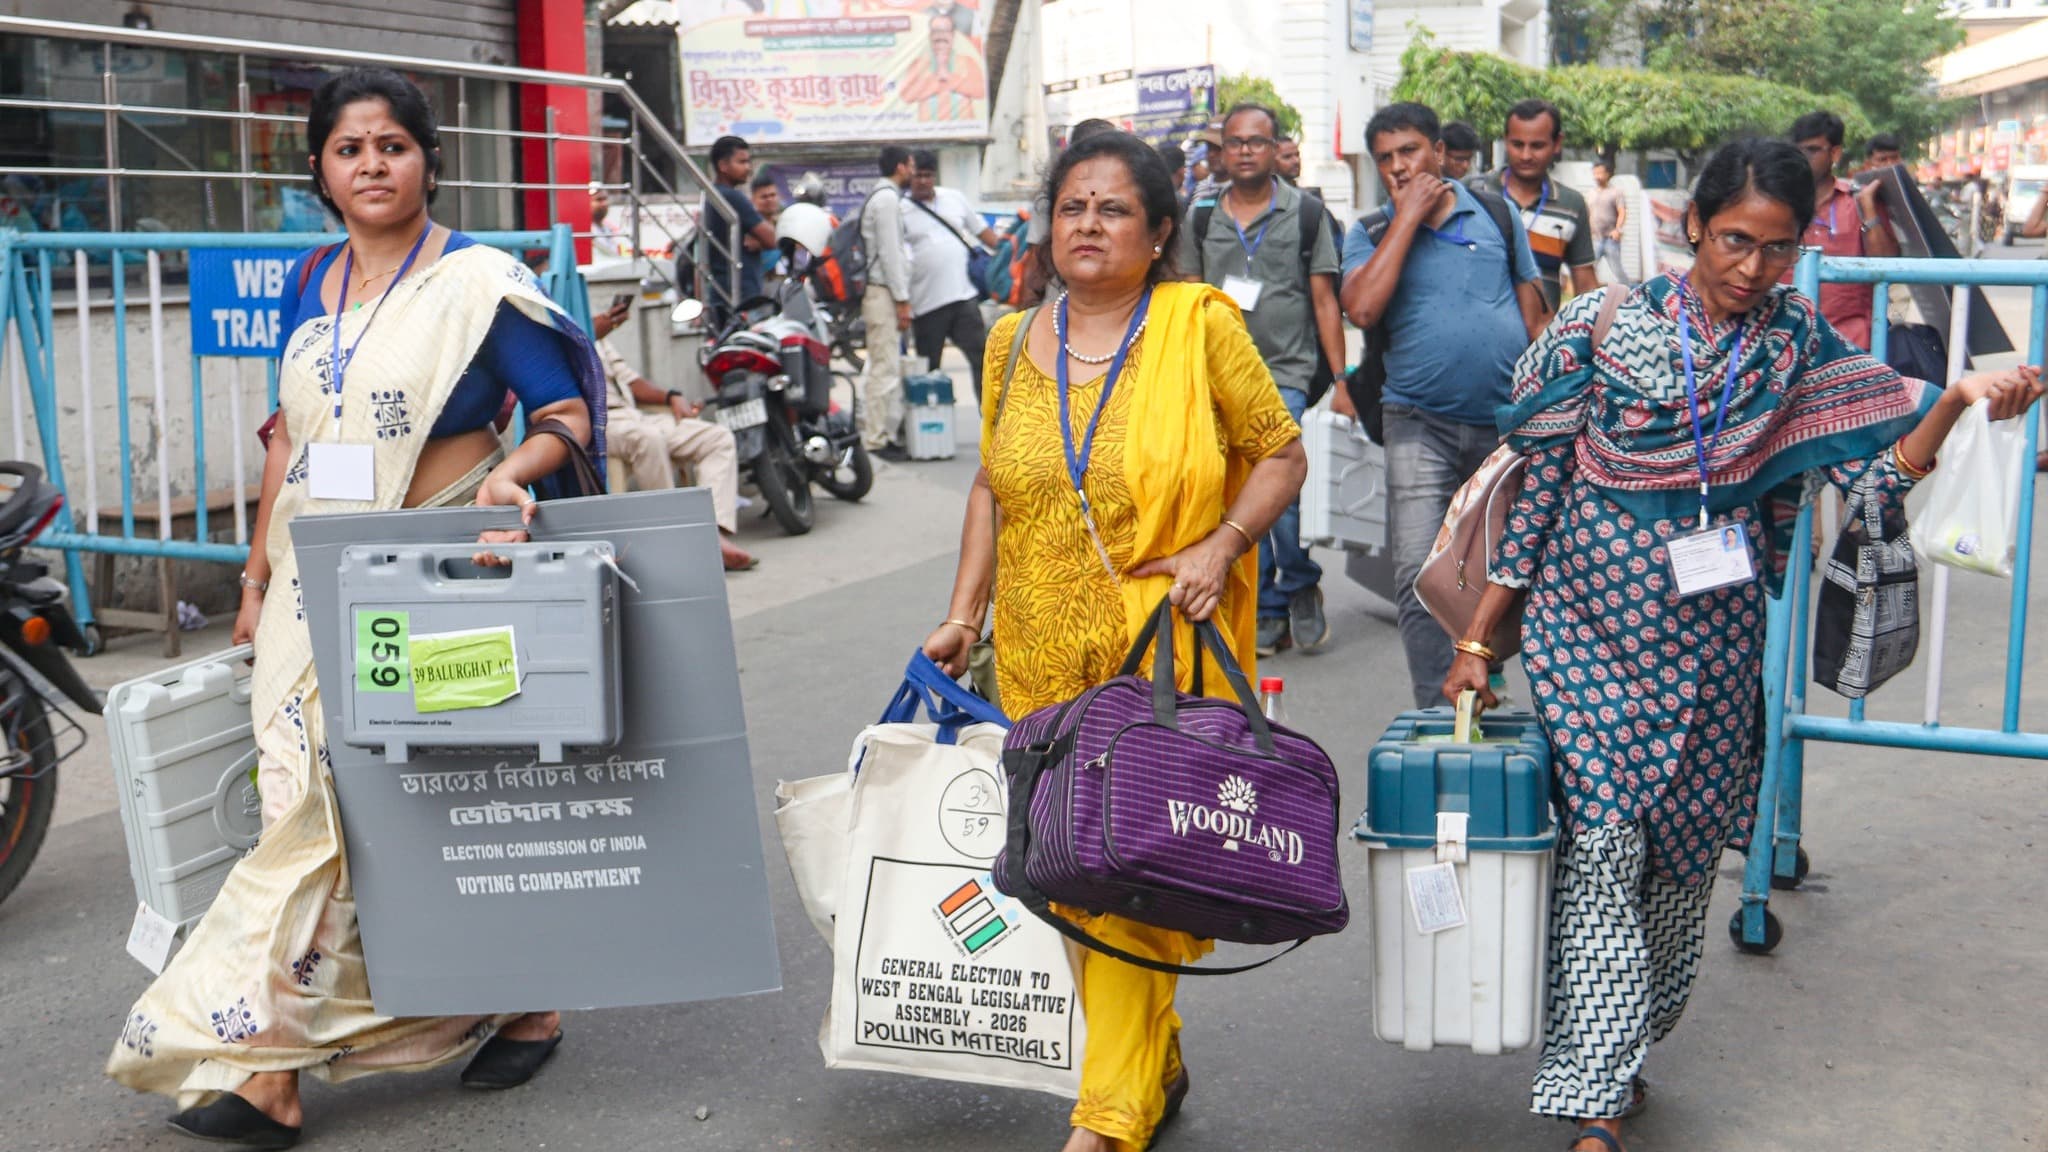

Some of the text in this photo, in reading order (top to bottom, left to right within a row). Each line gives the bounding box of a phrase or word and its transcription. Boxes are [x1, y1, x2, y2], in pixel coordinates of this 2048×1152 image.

[767, 74, 834, 117] কুমার
[839, 73, 882, 103] রায়
[231, 258, 297, 299] WB
[370, 617, 401, 687] 059
[414, 667, 425, 684] 39
[427, 660, 493, 683] BALURGHAT
[368, 718, 393, 726] Election
[400, 768, 488, 795] ভারতের
[493, 760, 577, 790] নির্বাচন
[449, 797, 634, 826] ভোটদান কক্ষ
[962, 816, 989, 837] 59
[442, 834, 647, 862] ELECTION COMMISSION OF INDIA
[1167, 798, 1304, 866] WOODLAND
[456, 866, 641, 895] VOTING COMPARTMENT
[881, 957, 1050, 990] GENERAL ELECTION TO
[861, 977, 1066, 1015] WEST BENGAL LEGISLATIVE
[895, 1003, 971, 1027] ASSEMBLY
[990, 1013, 1027, 1033] 2026
[863, 1020, 1062, 1061] POLLING MATERIALS
